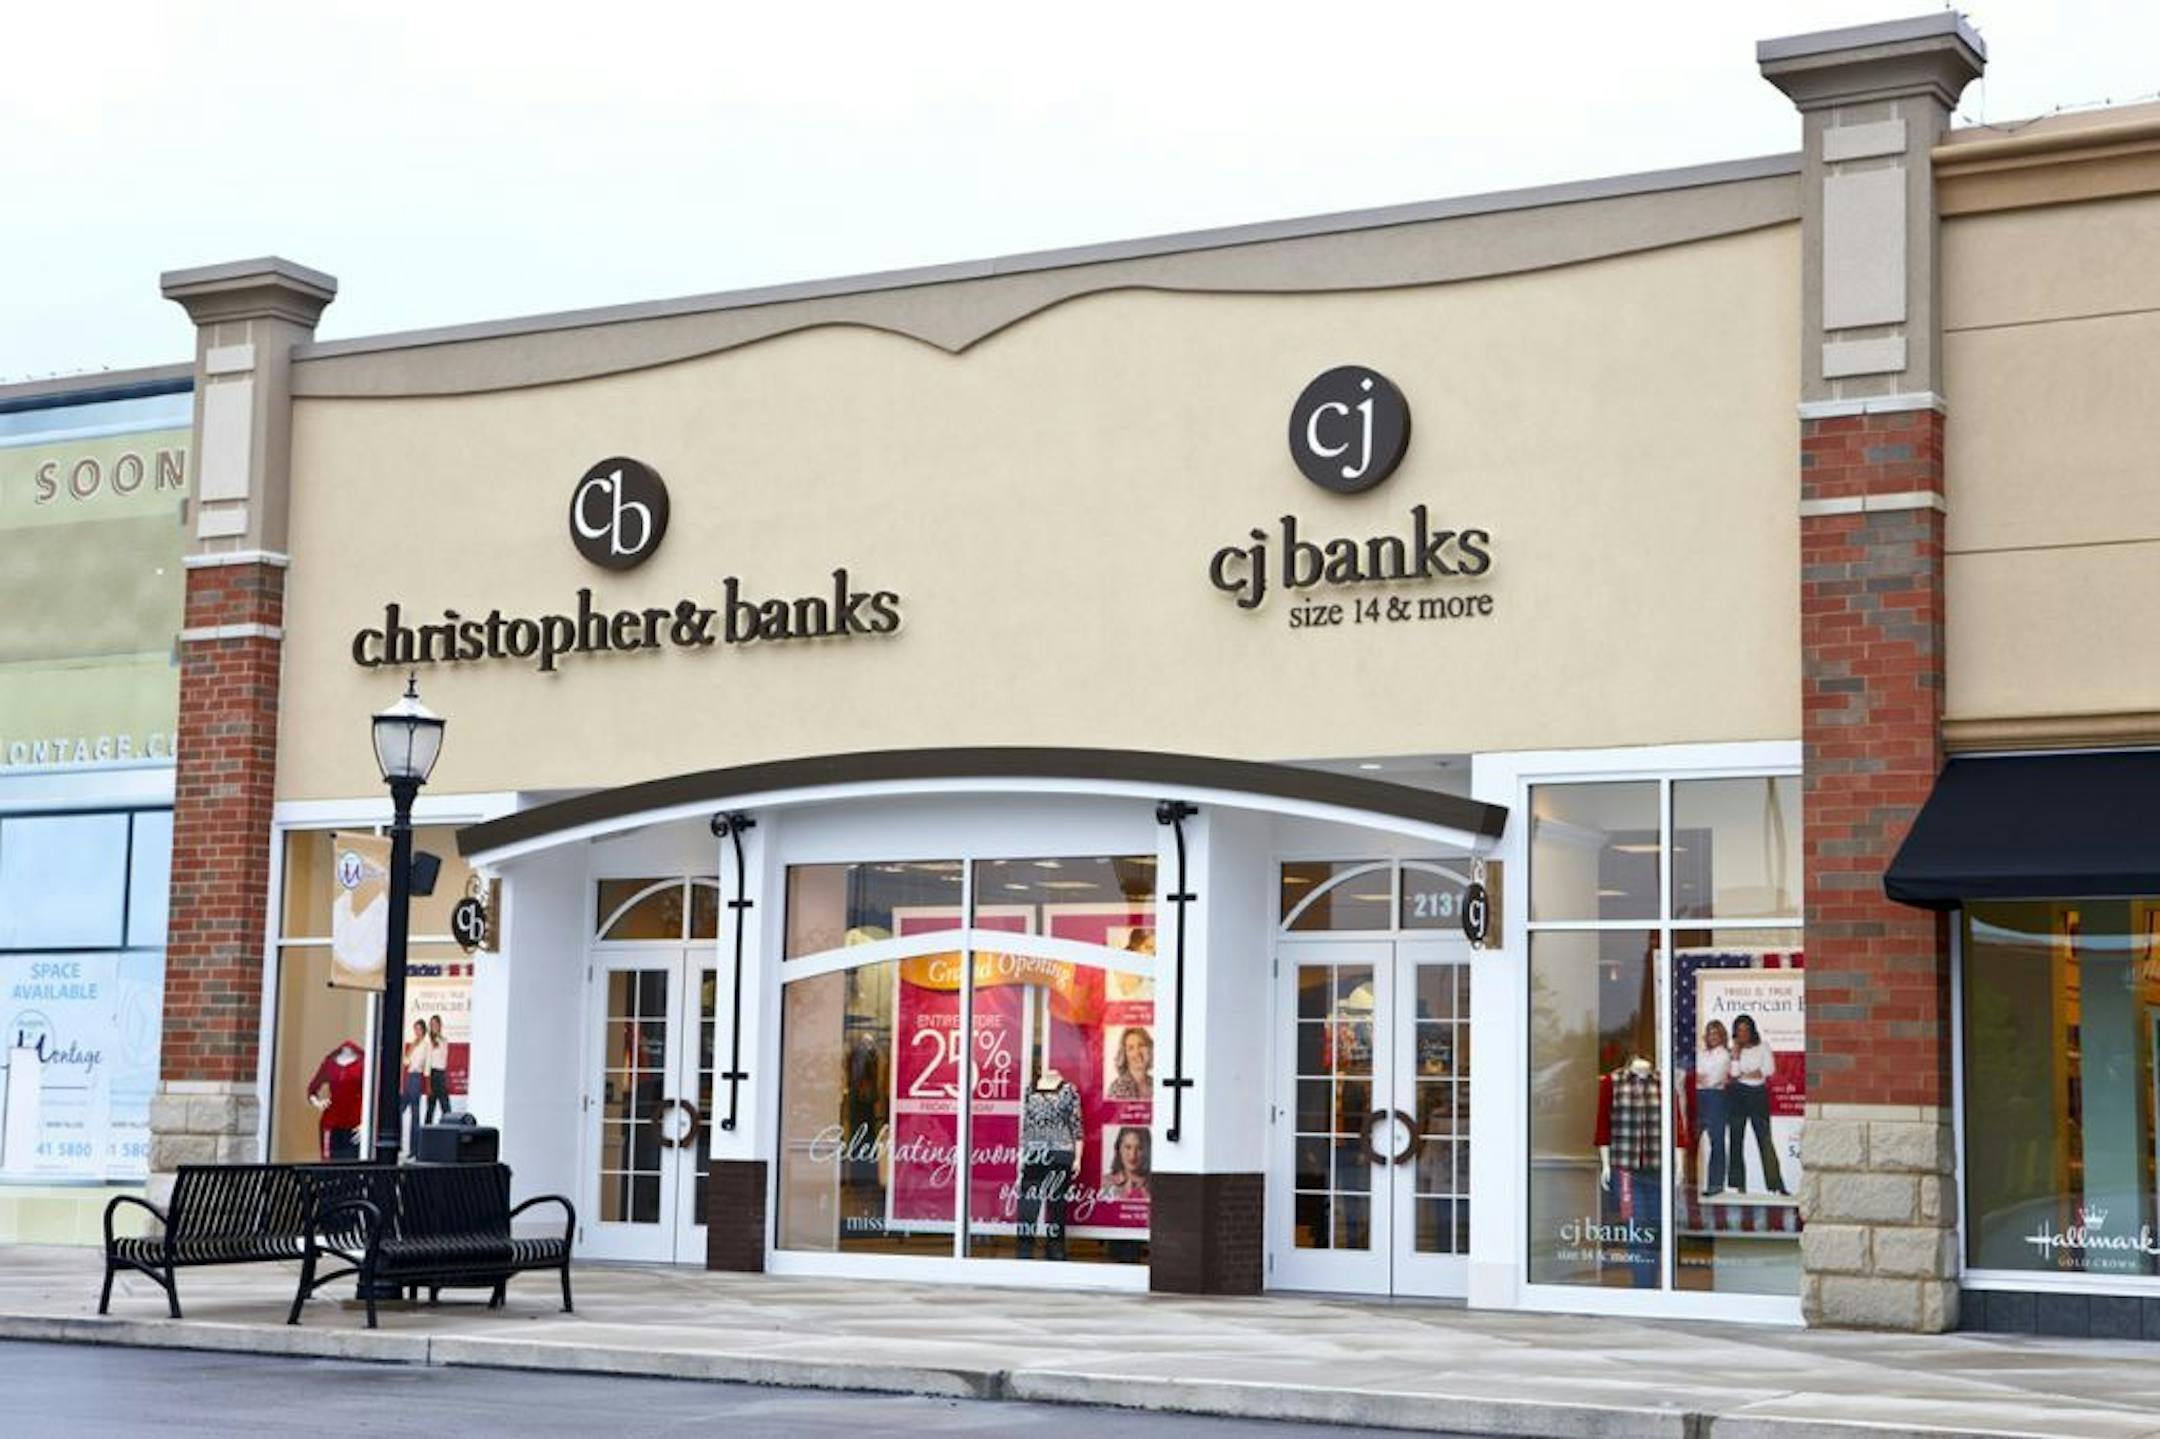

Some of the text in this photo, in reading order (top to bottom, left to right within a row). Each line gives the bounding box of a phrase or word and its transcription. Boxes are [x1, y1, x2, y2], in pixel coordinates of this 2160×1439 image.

[1307, 377, 1374, 478] cj
[34, 449, 185, 504] SOON
[574, 469, 652, 556] cb
[1209, 504, 1491, 608] cj banks
[723, 568, 900, 644] banks
[1289, 592, 1494, 628] size 14 & more
[14, 982, 98, 1000] AVAILABLE
[31, 962, 81, 979] SPACE
[1712, 996, 1792, 1013] American
[1560, 1217, 1656, 1246] cj banks
[2024, 1219, 2160, 1261] Hallmark
